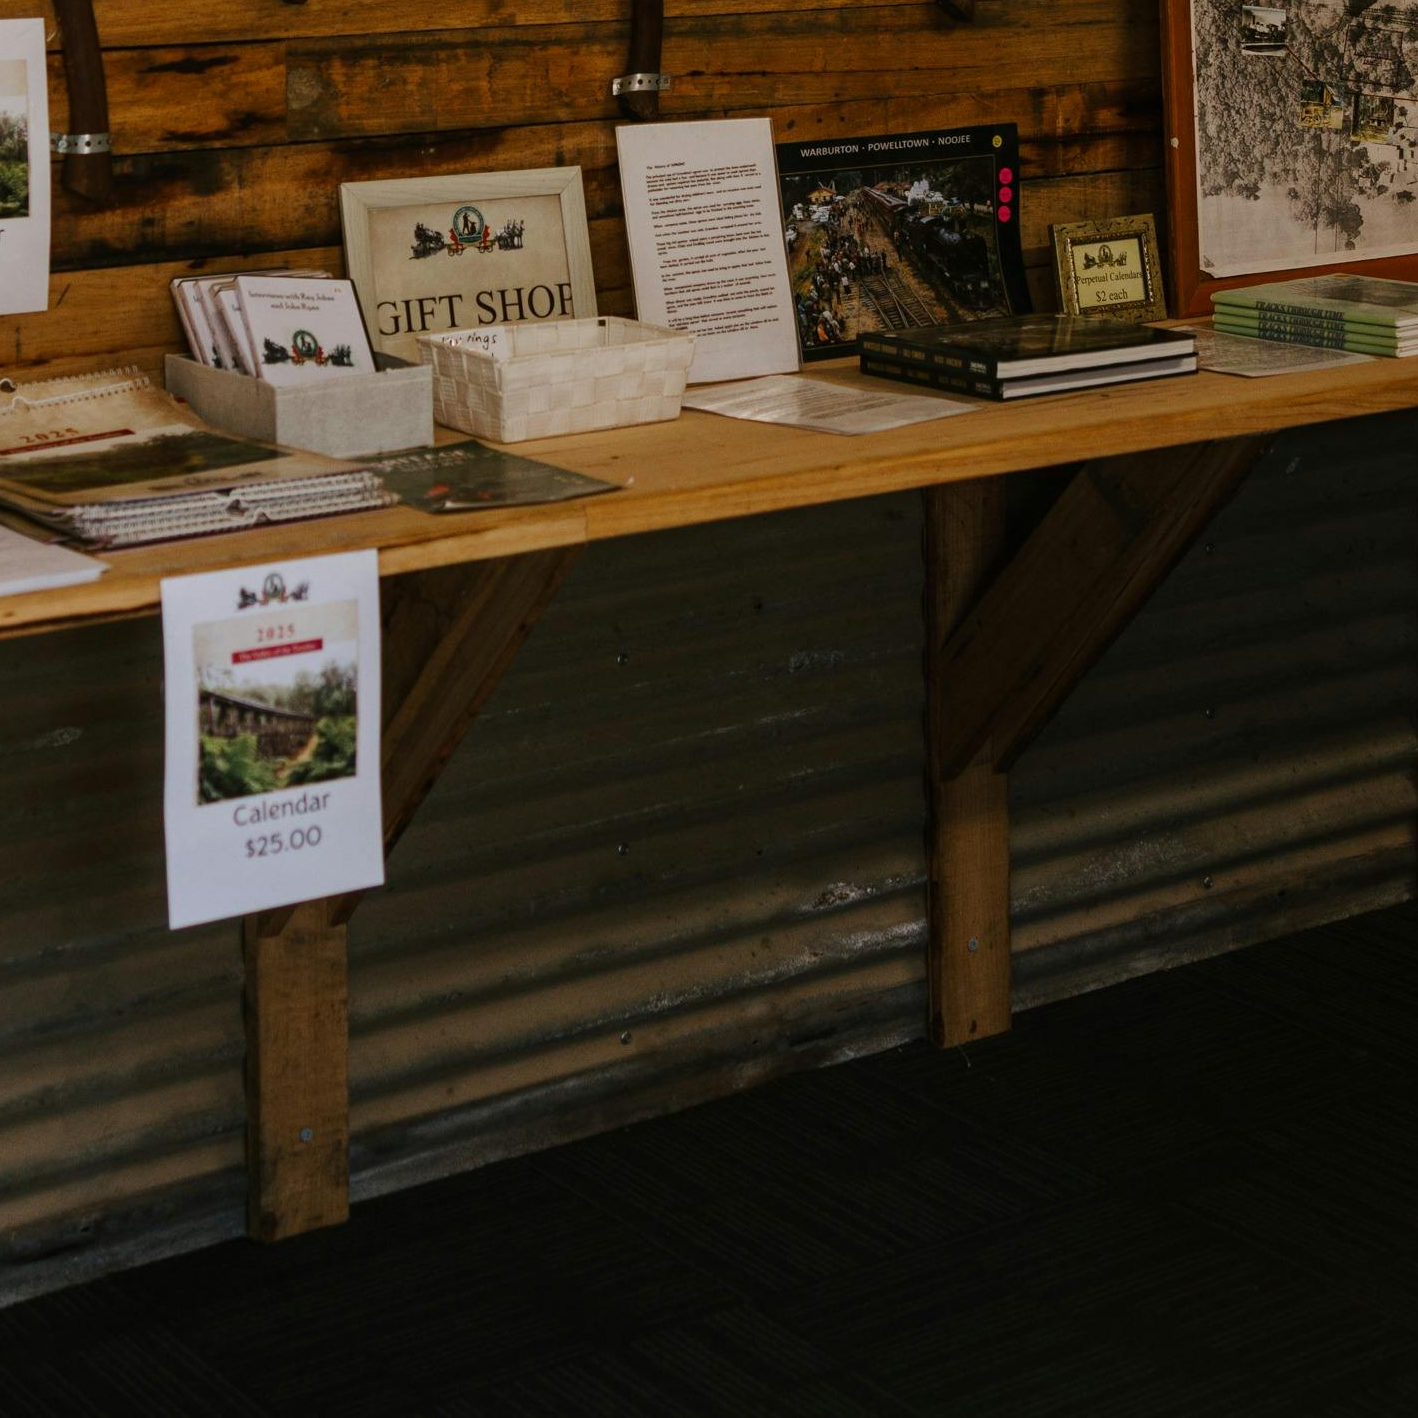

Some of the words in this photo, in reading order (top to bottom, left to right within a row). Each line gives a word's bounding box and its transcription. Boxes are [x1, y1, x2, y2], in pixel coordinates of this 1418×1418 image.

[800, 145, 859, 158] WARBURTON
[868, 138, 929, 152] POWELLTOWN
[938, 134, 971, 146] NOOJEE
[1074, 273, 1108, 285] Perpetual
[1109, 269, 1143, 281] Calendars
[1095, 290, 1106, 302] $2
[1109, 289, 1128, 300] each
[376, 293, 463, 337] GIFT
[476, 284, 572, 326] SHOP
[1255, 300, 1286, 314] TRACKS
[1287, 305, 1323, 318] THROUGH
[1325, 310, 1344, 320] TIME
[467, 332, 497, 350] rings
[20, 427, 80, 445] 2025
[256, 624, 295, 642] 2025
[233, 793, 330, 828] Calendar
[246, 825, 322, 858] $25.00
